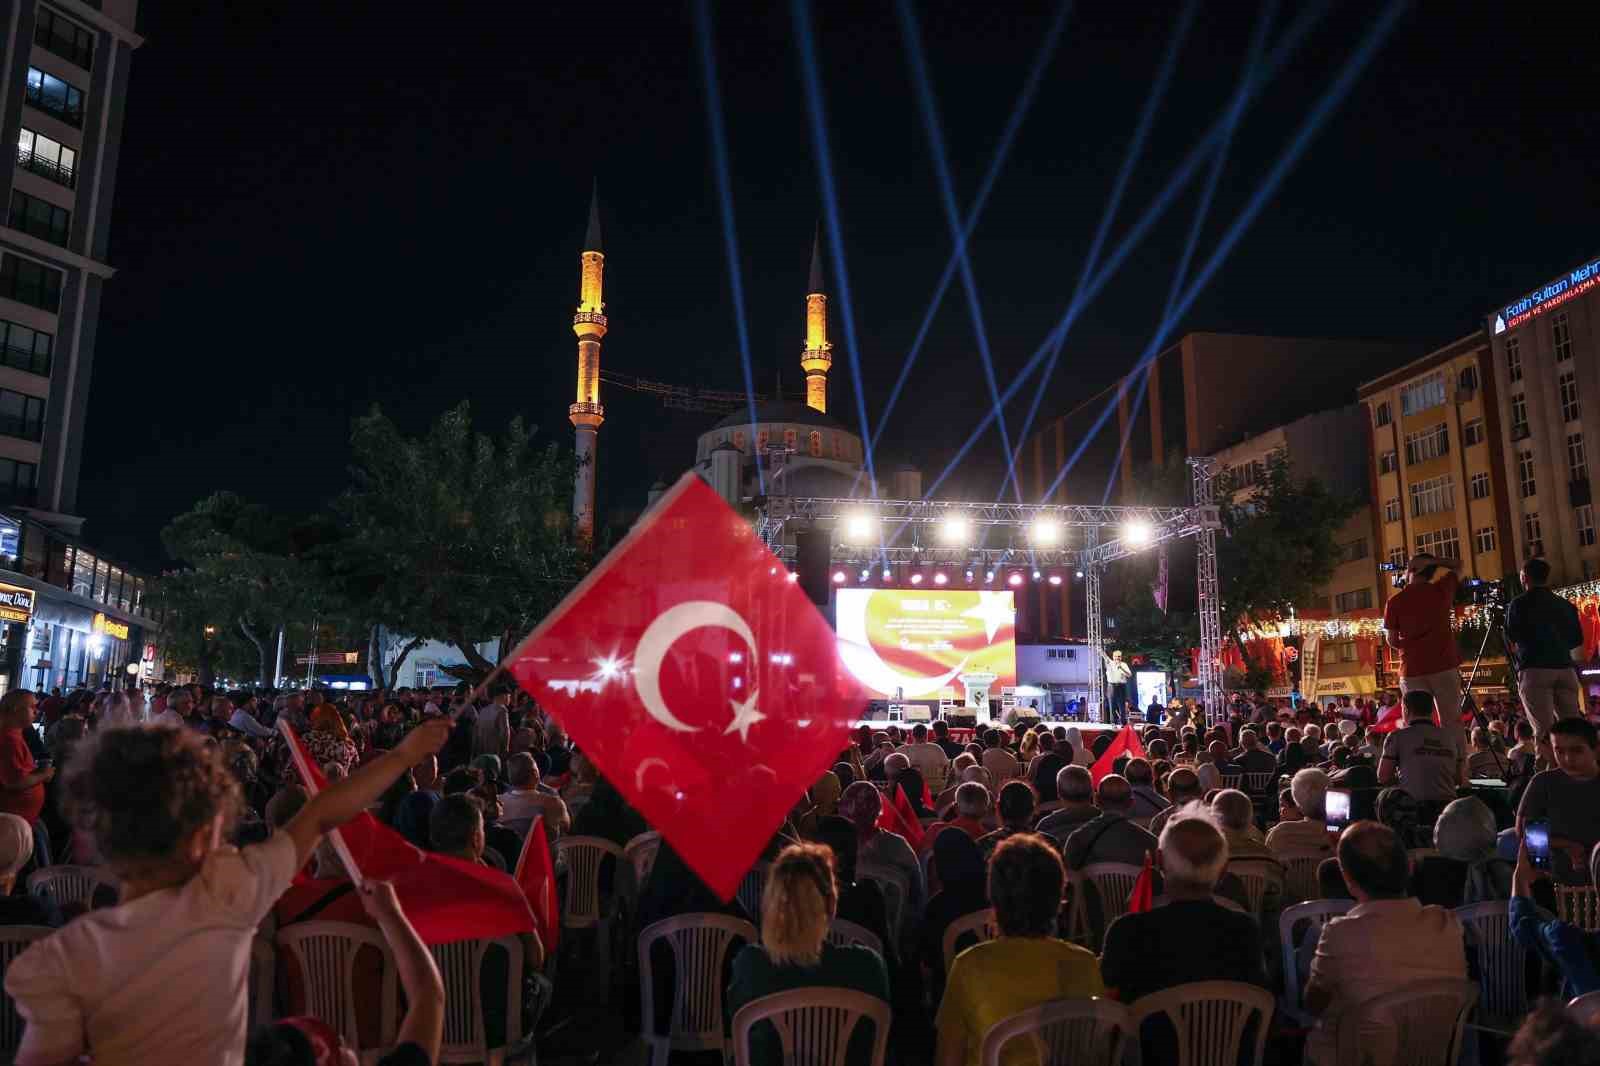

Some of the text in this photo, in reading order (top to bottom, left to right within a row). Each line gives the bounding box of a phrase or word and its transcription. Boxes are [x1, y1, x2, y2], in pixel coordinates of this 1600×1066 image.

[1506, 297, 1532, 319] Fatih
[1532, 279, 1568, 304] Sultan
[1532, 305, 1542, 315] VE
